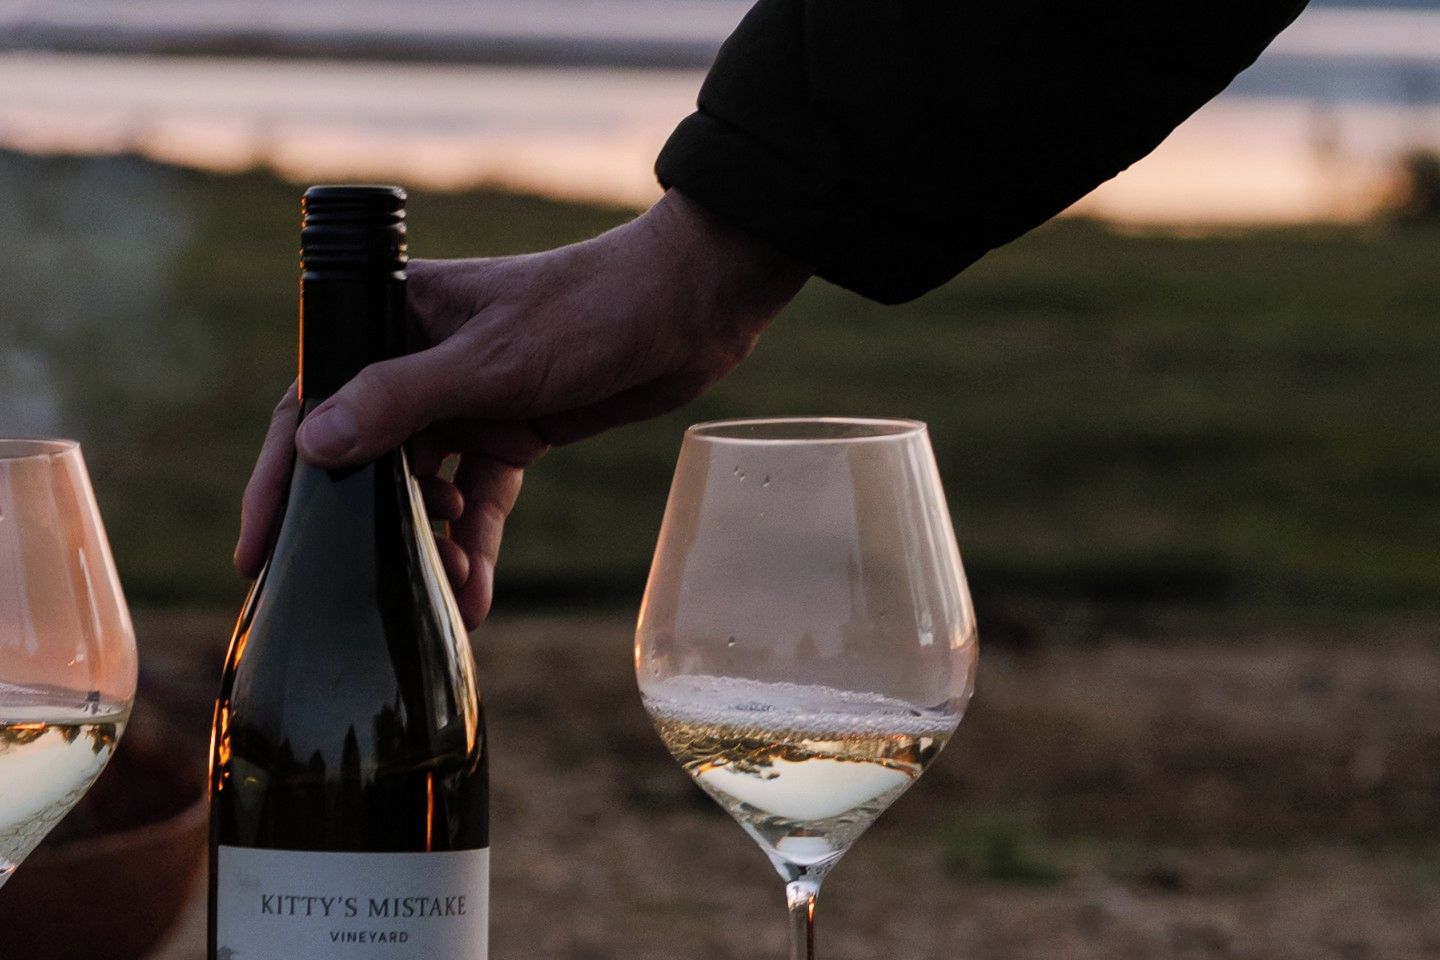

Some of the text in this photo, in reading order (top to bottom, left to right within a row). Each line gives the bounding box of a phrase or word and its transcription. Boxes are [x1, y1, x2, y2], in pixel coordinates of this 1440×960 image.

[260, 893, 467, 918] KITTY'S MISTAKE
[329, 931, 409, 944] VINEYARD
